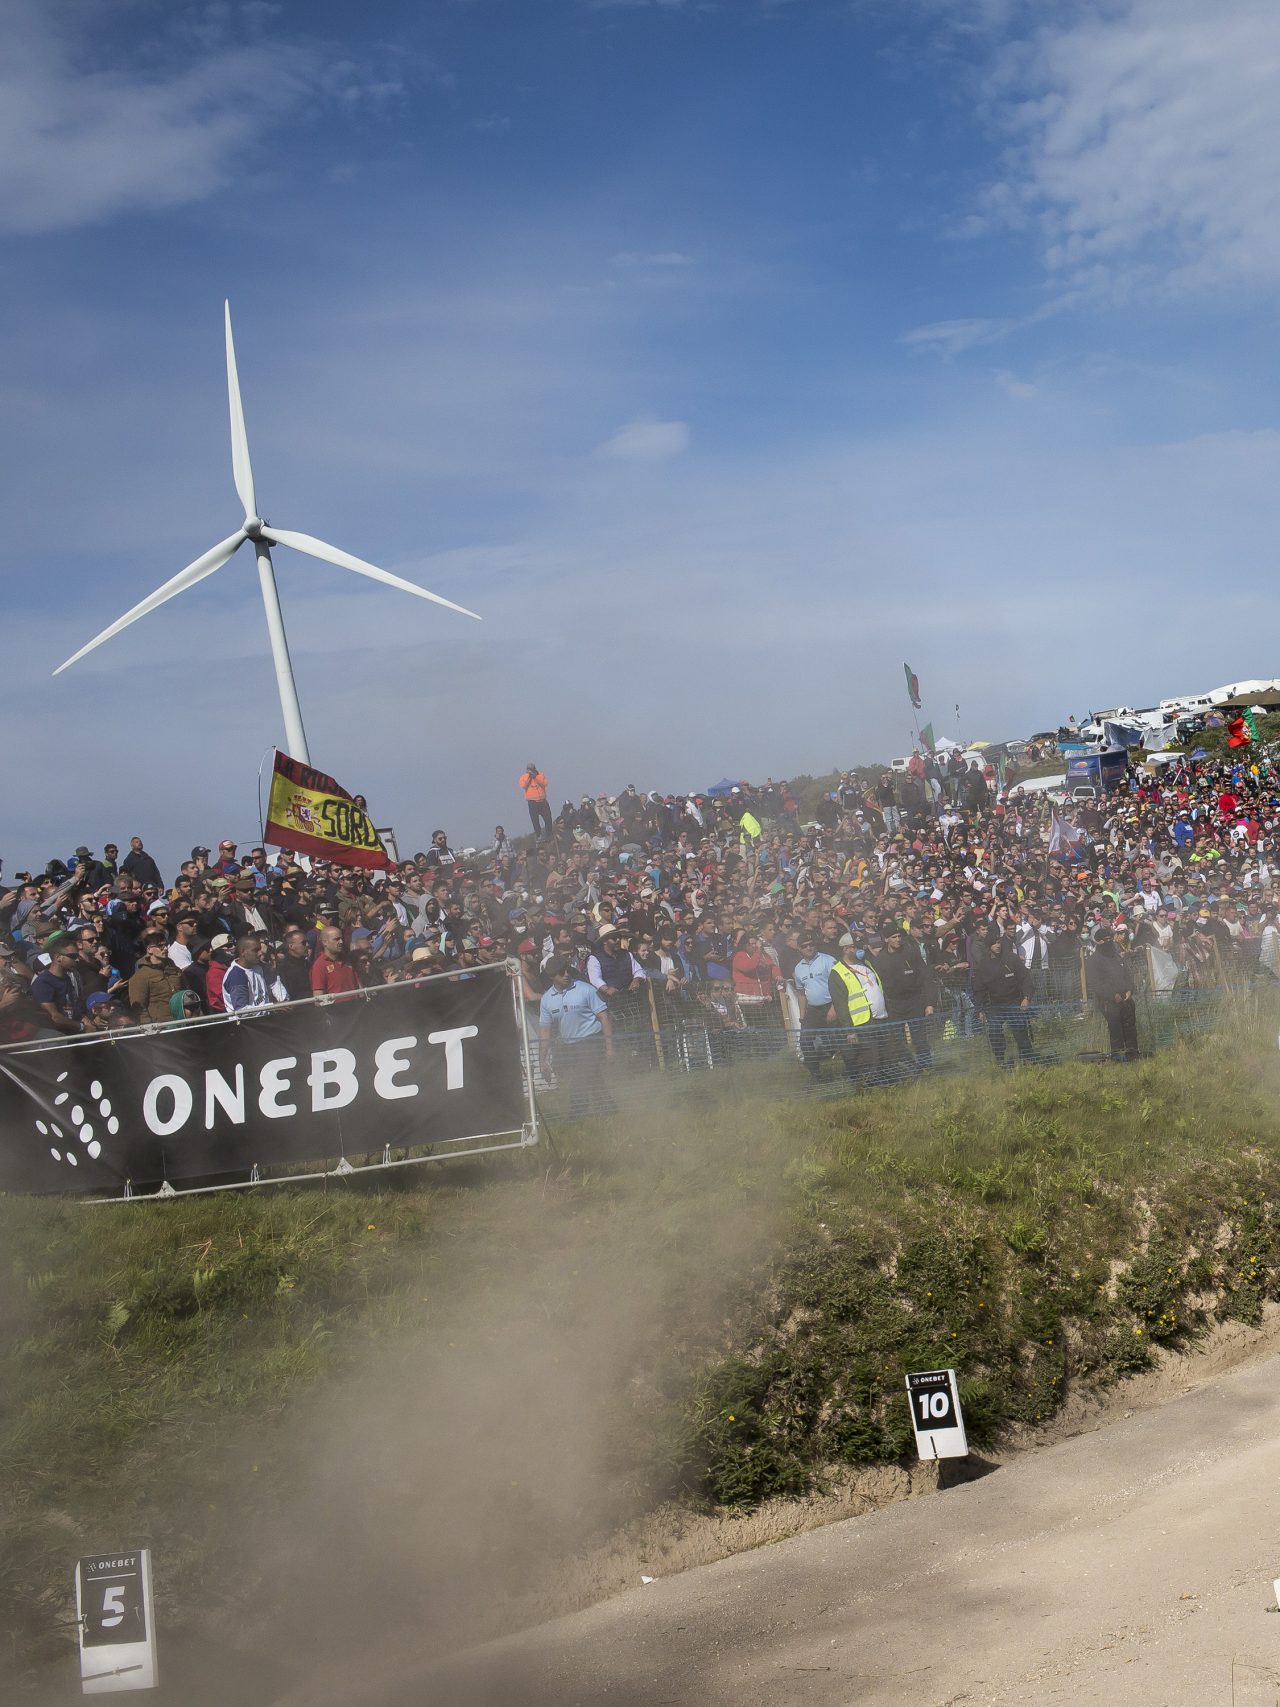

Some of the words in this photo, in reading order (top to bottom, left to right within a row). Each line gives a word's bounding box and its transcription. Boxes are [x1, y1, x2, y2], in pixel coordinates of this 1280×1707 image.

[143, 1025, 479, 1136] ONEBET
[920, 1375, 945, 1383] ONEBET
[919, 1391, 949, 1419] 10
[98, 1558, 136, 1570] ONEBET
[101, 1586, 125, 1627] 5
